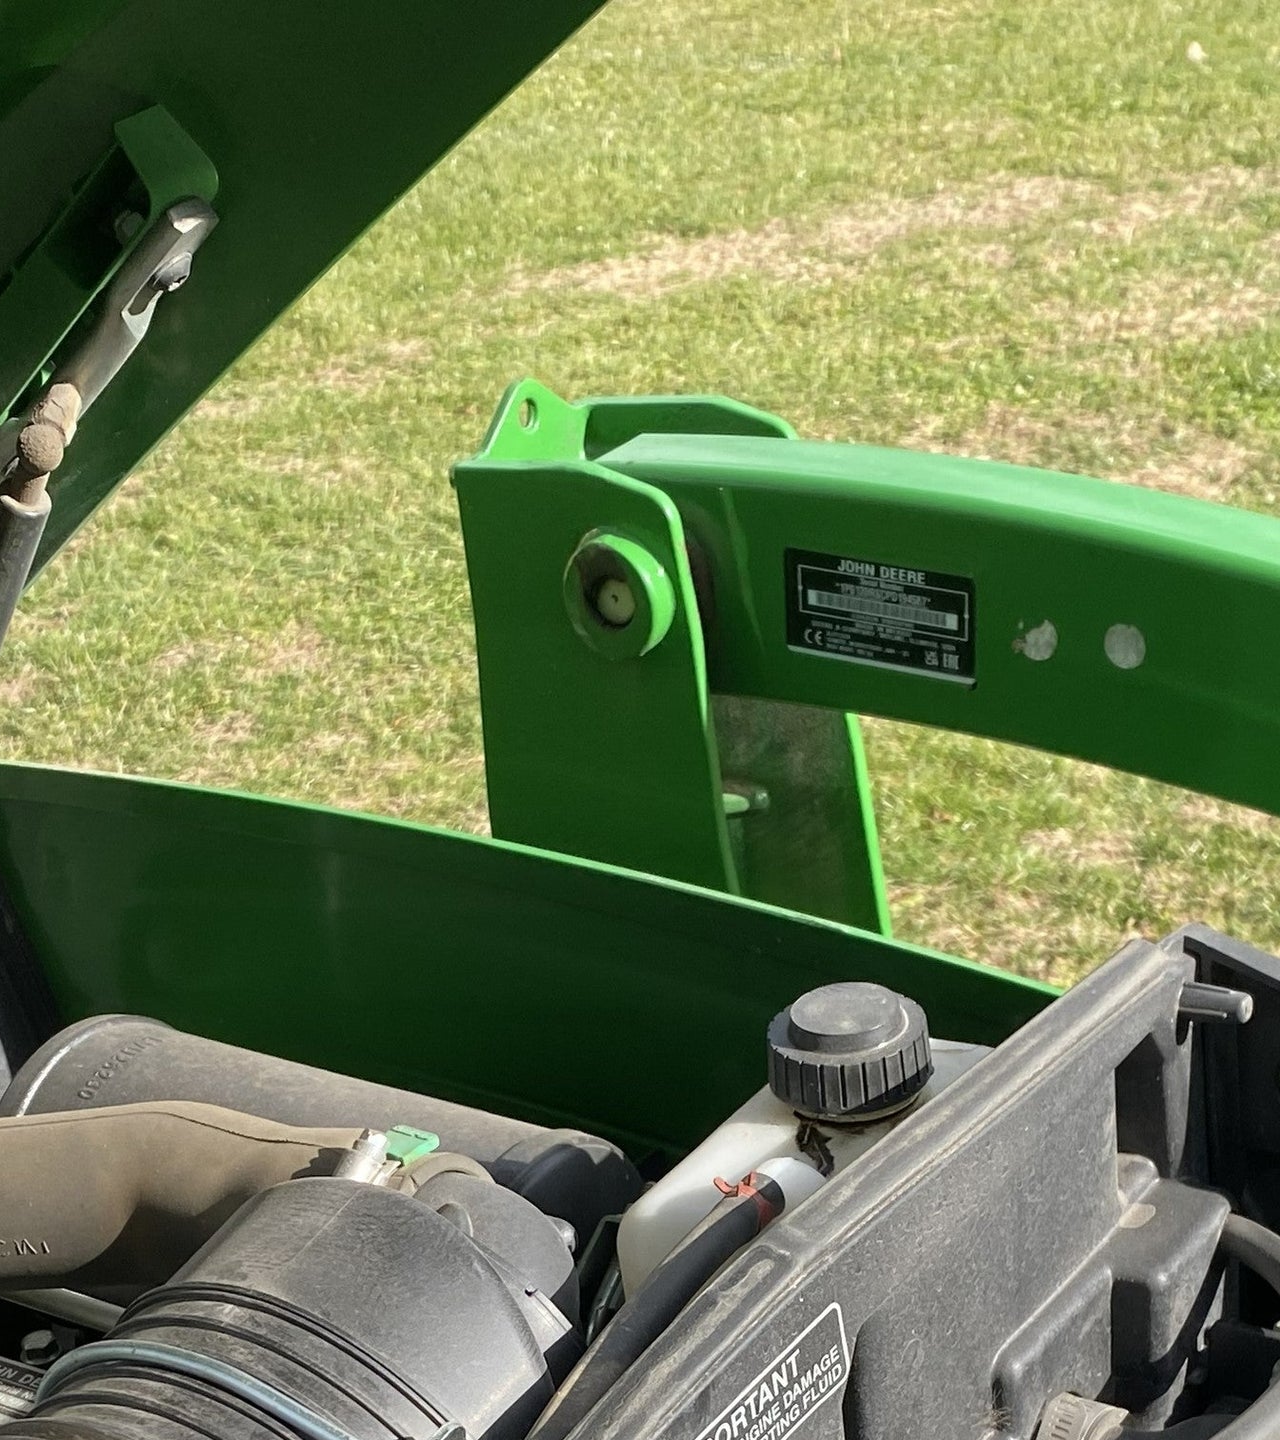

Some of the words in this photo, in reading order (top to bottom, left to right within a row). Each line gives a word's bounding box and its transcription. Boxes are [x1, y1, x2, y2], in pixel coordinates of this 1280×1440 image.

[837, 558, 876, 578] JOHN
[879, 565, 926, 585] DEERE
[783, 1344, 840, 1408] DAMAGE
[802, 1363, 843, 1416] FLUID
